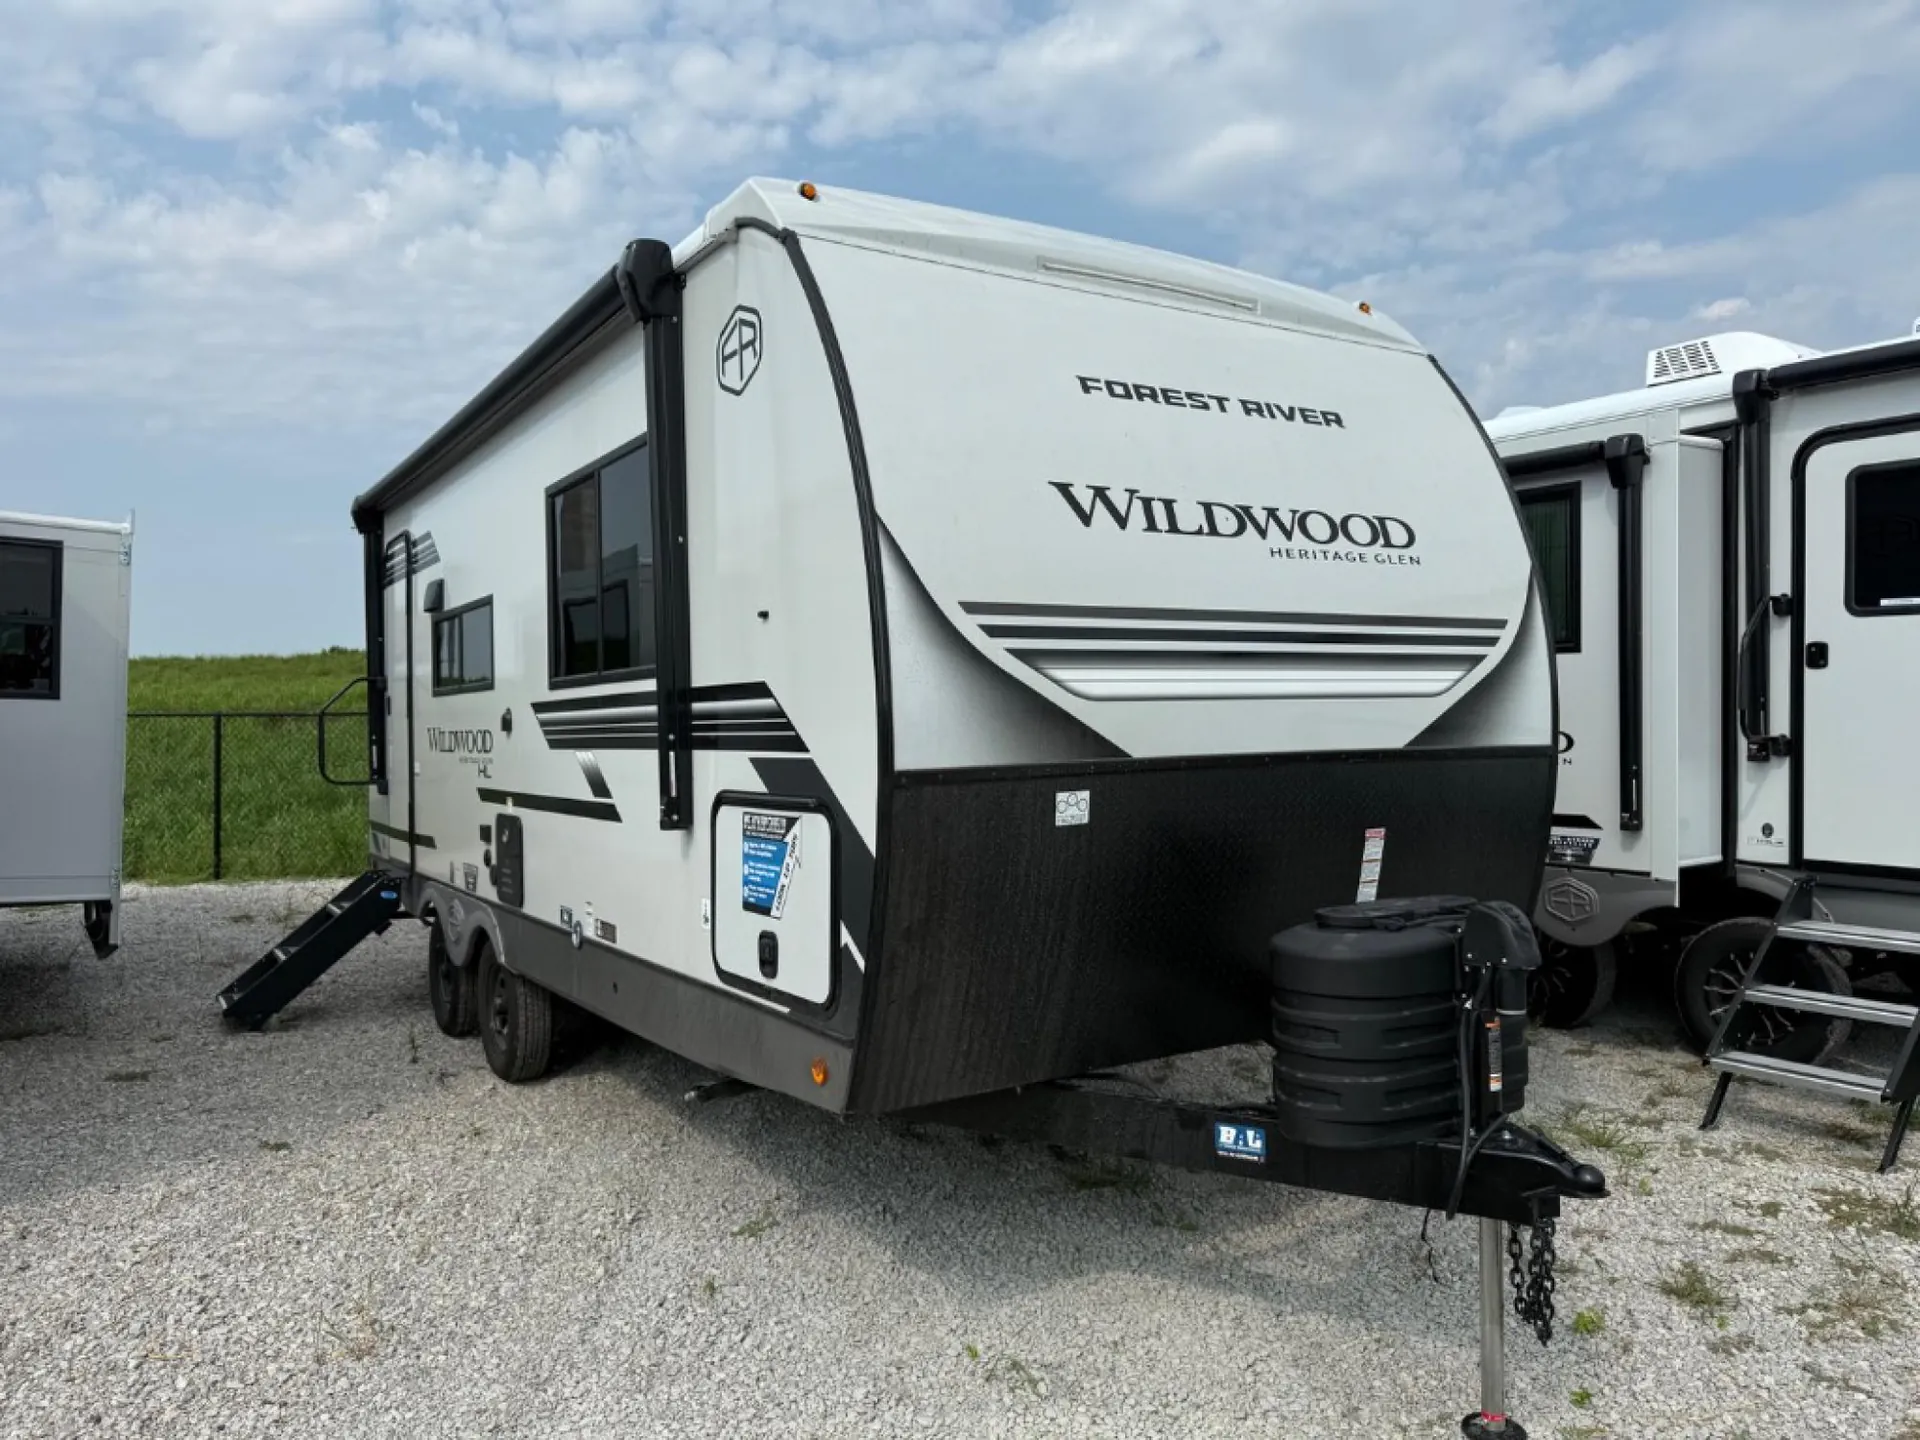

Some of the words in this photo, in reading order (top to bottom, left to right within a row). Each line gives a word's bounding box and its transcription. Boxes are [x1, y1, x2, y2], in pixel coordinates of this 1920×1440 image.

[1075, 375, 1230, 413] FOREST
[1238, 399, 1346, 428] RIVER
[1048, 480, 1417, 549] WILDWOOD
[1269, 547, 1368, 563] HERITAGE
[1374, 552, 1422, 566] GLEN
